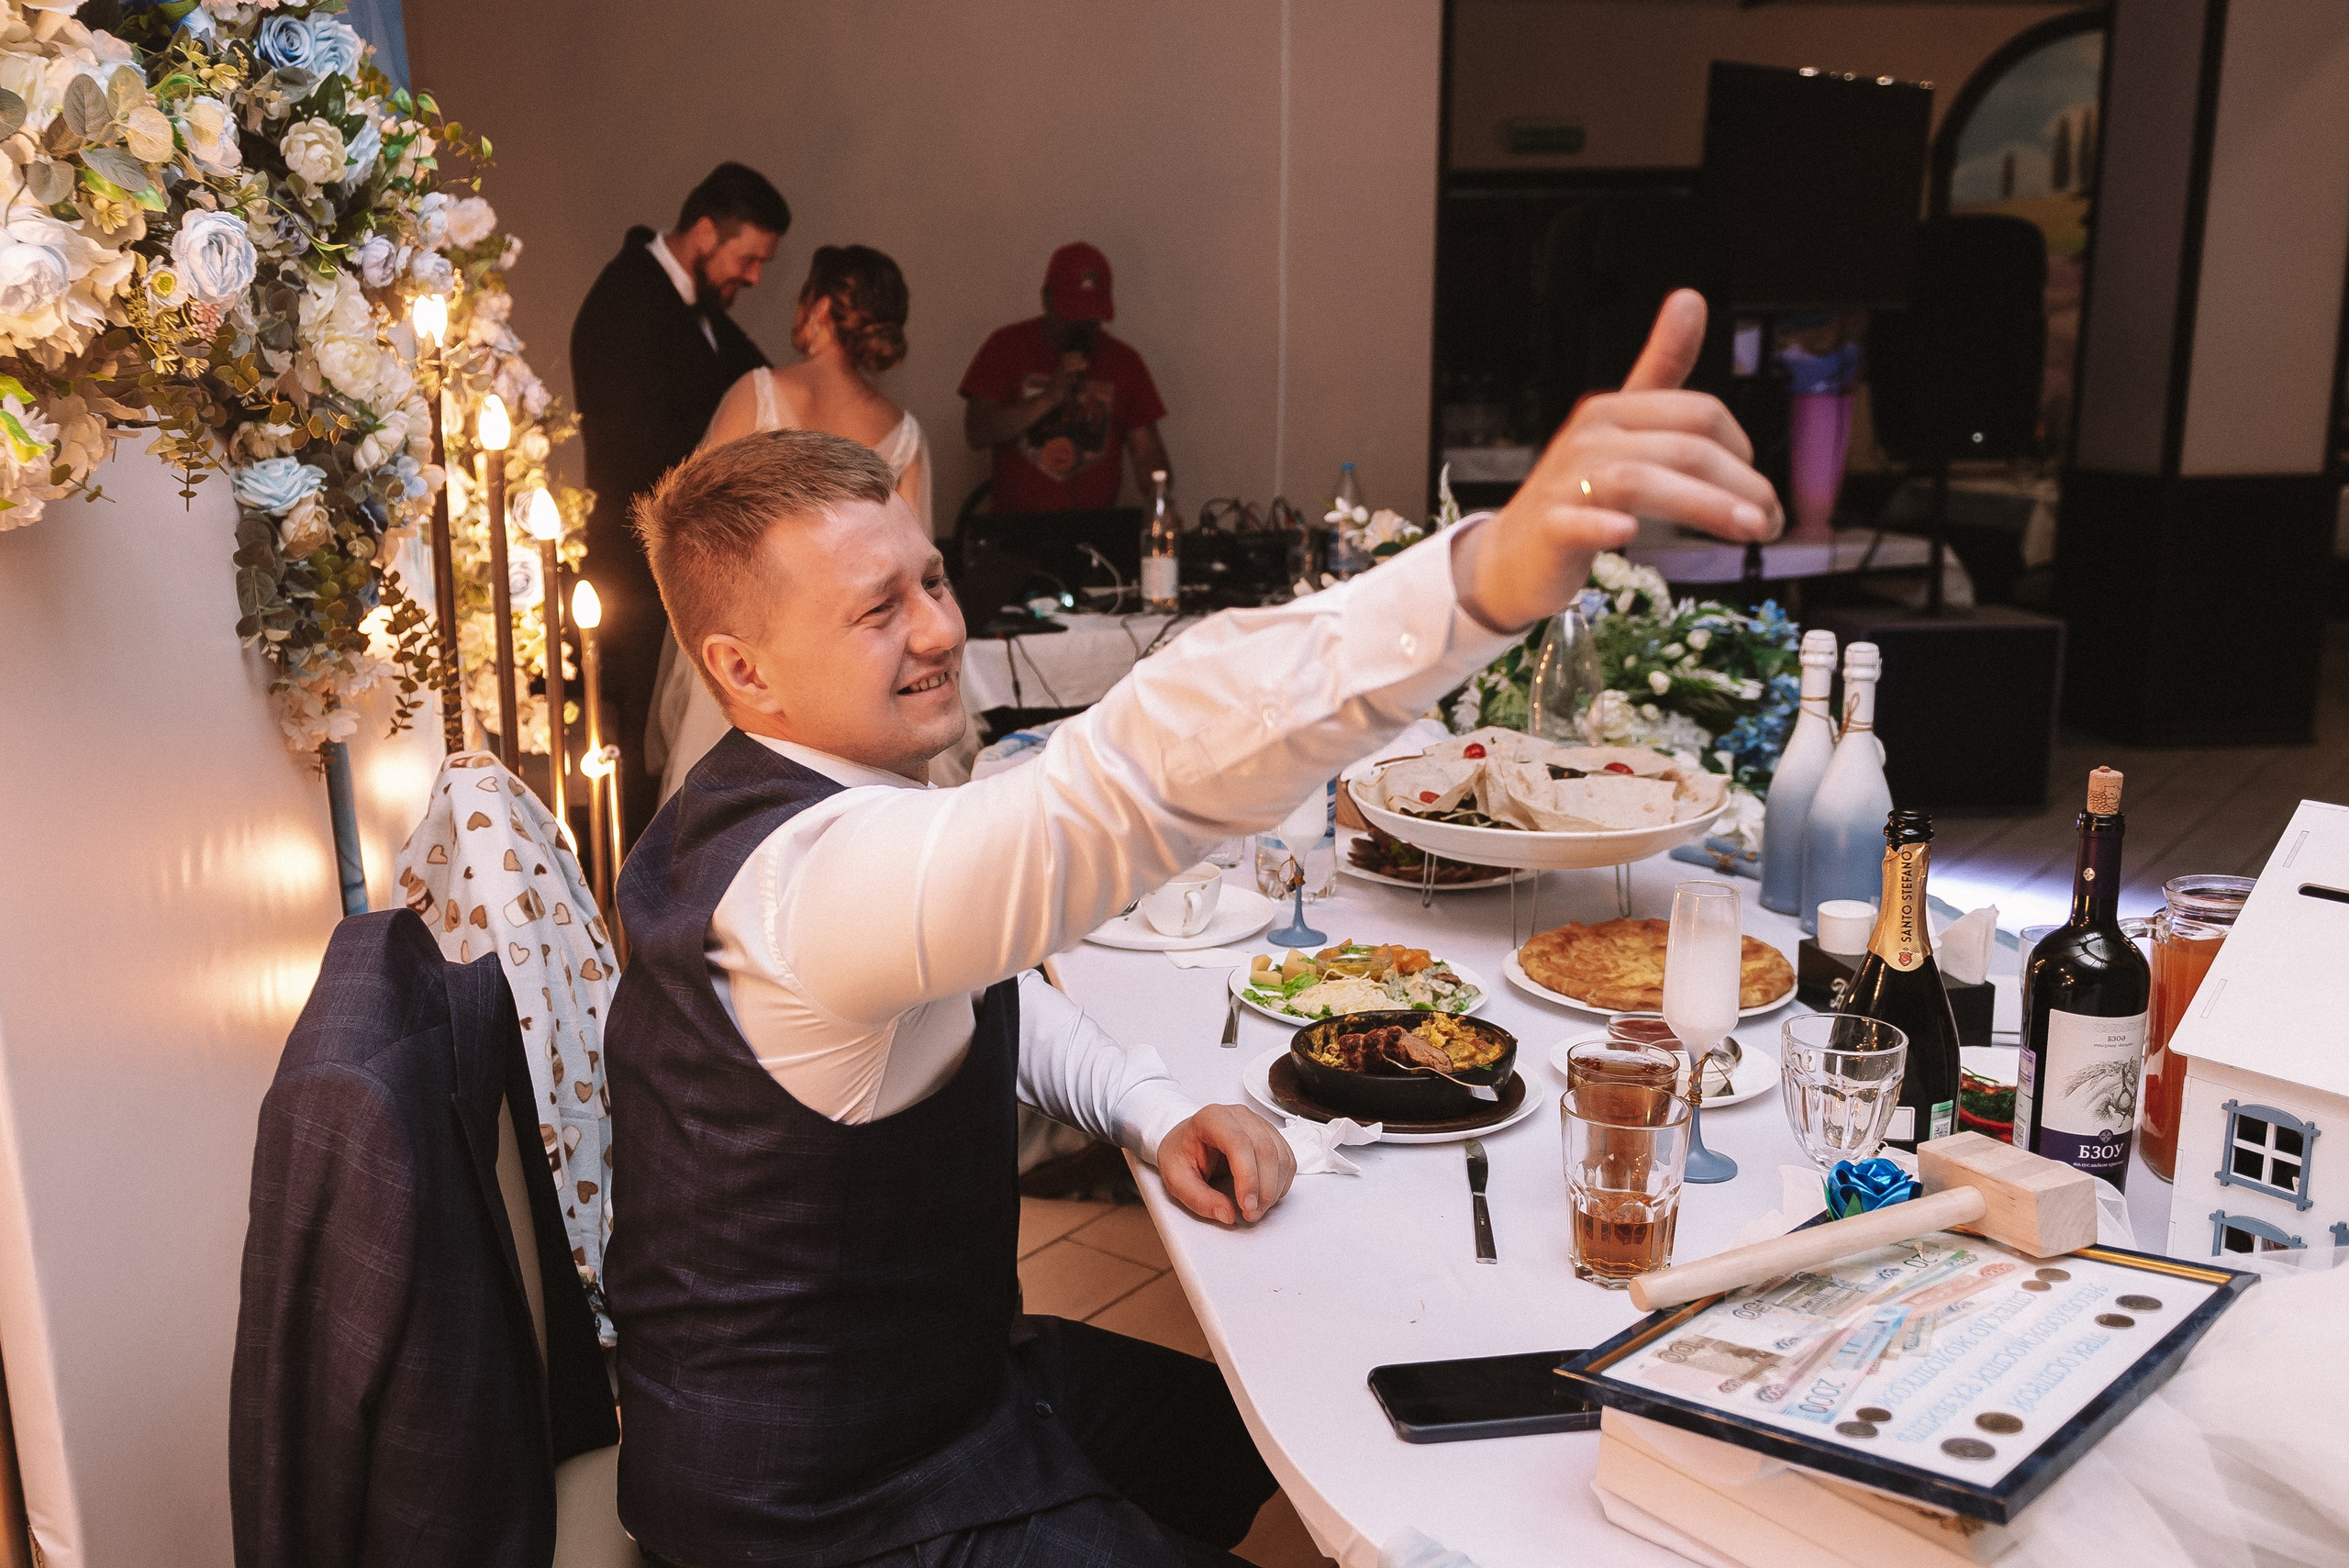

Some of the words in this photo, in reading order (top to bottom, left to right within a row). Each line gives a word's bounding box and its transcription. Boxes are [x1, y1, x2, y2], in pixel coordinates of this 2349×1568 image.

[1901, 851, 1912, 901] STEFANO
[1901, 905, 1912, 942] SANTO
[2077, 1142, 2124, 1159] БЗОУ
[1798, 1379, 1847, 1414] 2000
